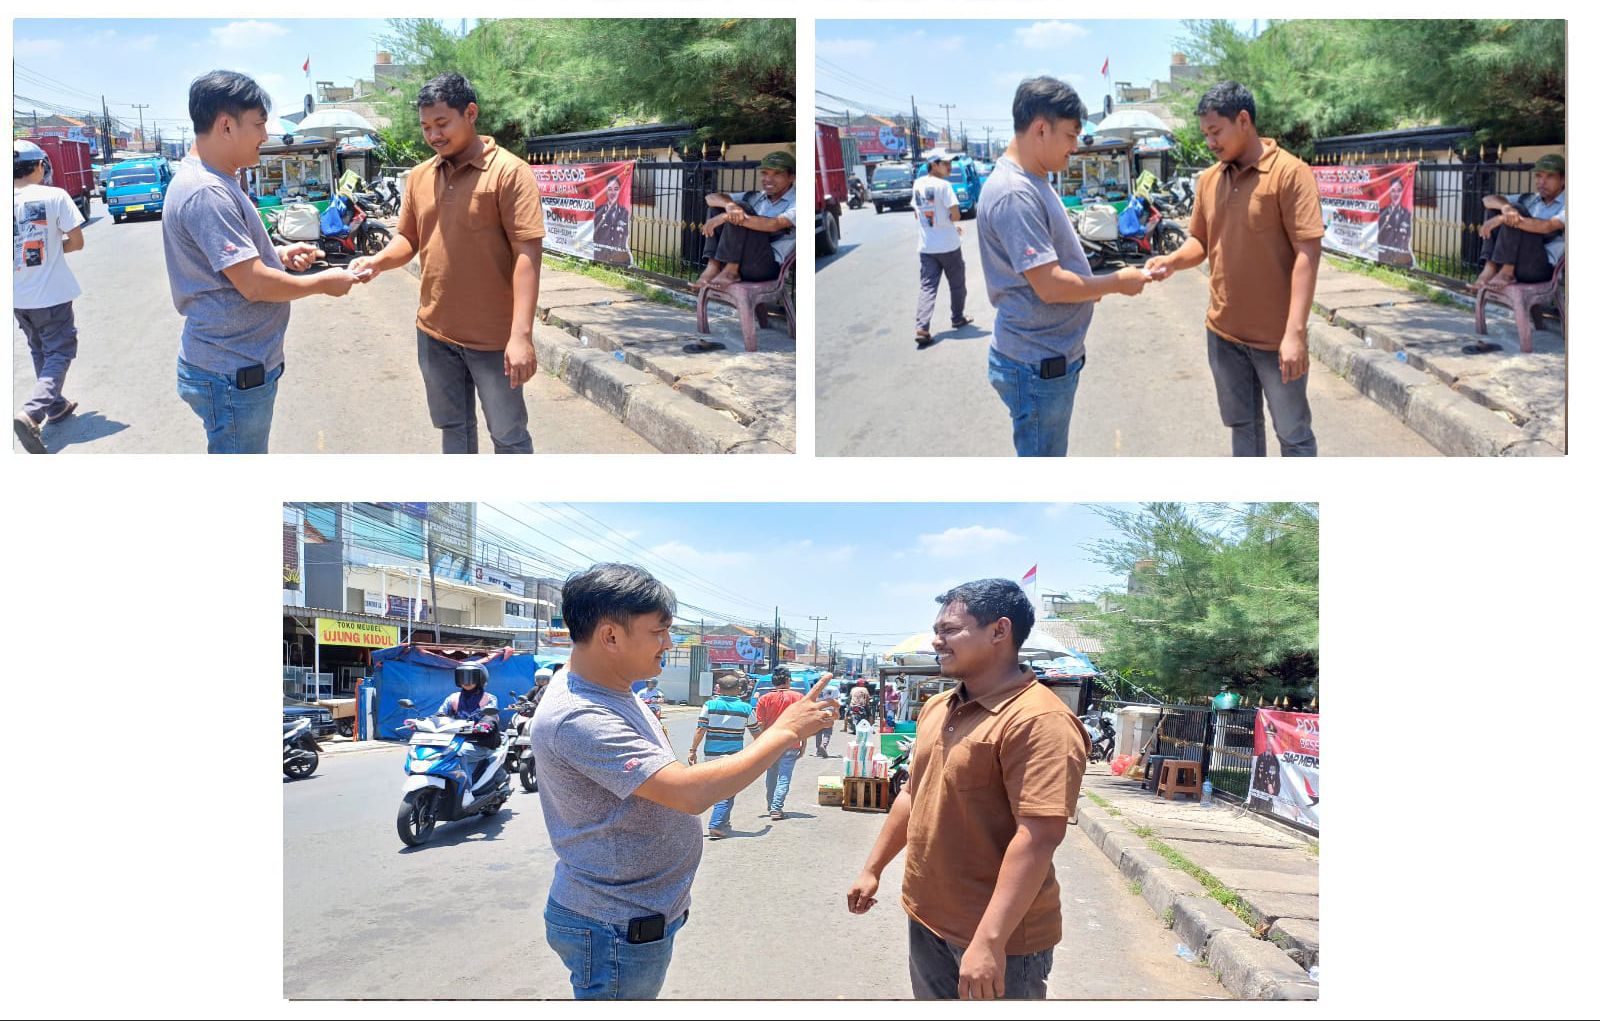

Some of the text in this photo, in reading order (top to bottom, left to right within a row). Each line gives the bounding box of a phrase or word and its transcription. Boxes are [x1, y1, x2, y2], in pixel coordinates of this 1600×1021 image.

[551, 169, 585, 181] BOGOR
[546, 211, 562, 222] PON
[337, 621, 381, 632] TOKO MEUBEL
[323, 629, 393, 646] UJUNG KIDUL
